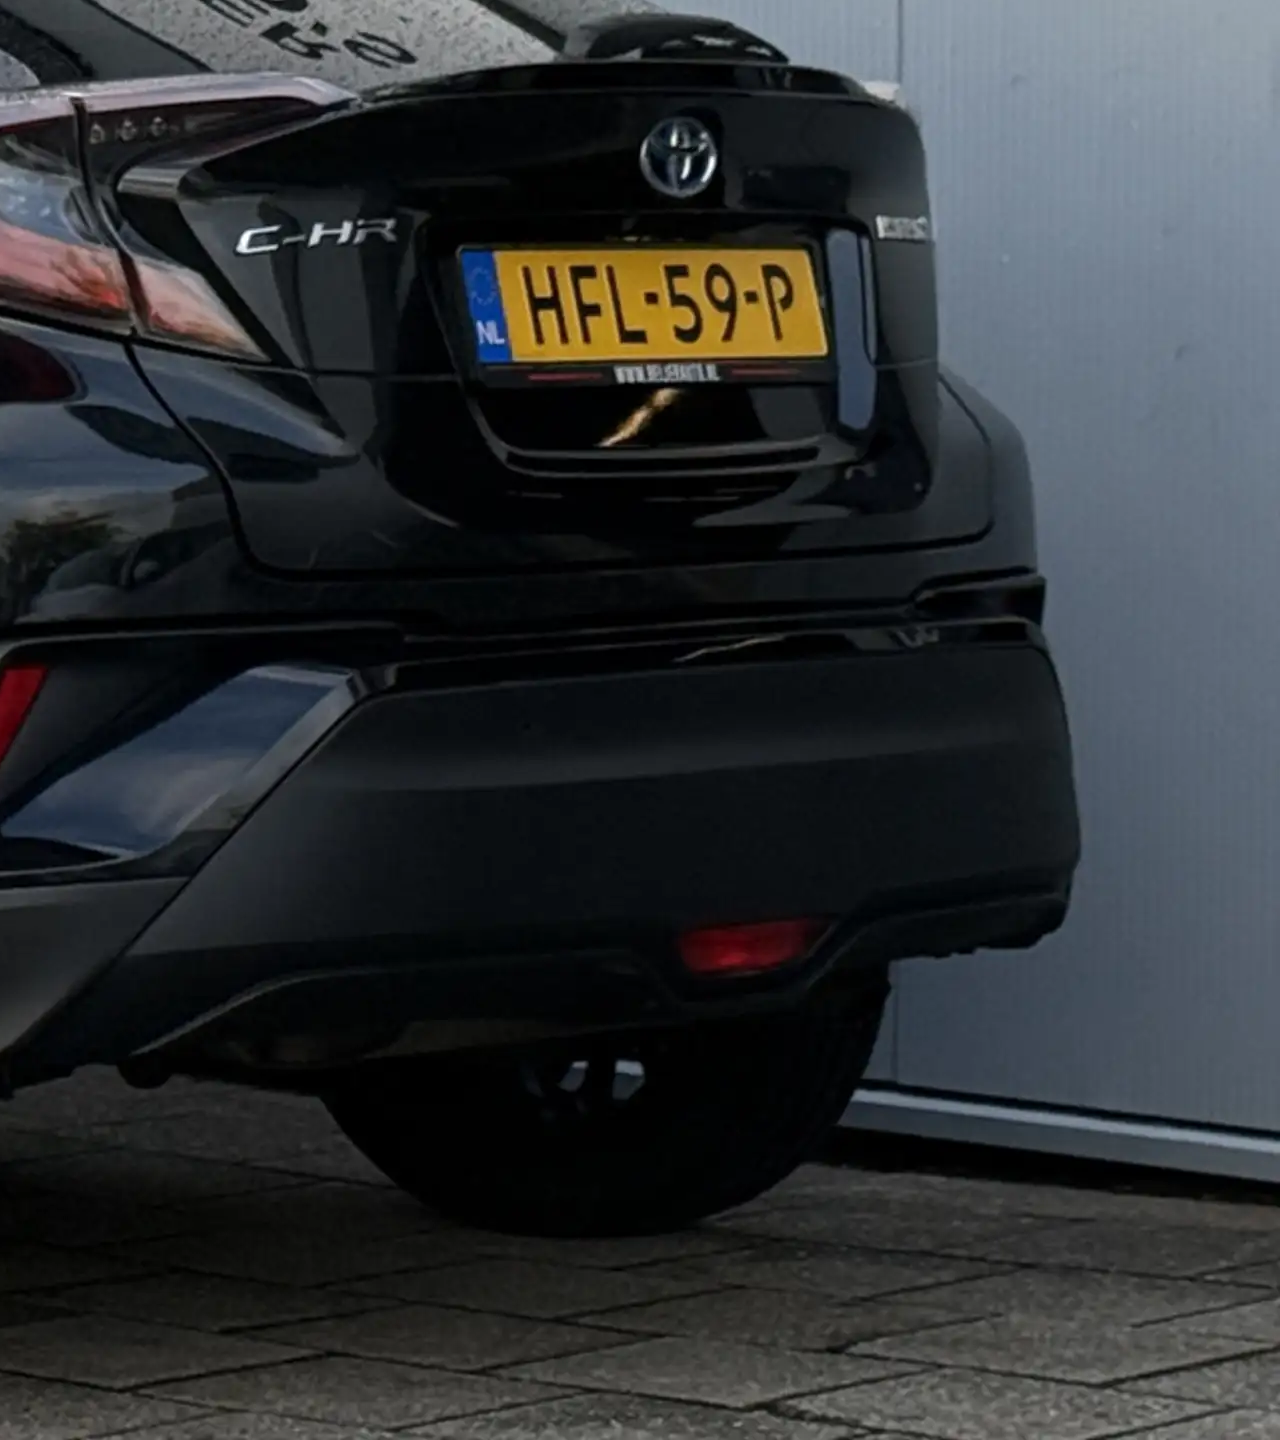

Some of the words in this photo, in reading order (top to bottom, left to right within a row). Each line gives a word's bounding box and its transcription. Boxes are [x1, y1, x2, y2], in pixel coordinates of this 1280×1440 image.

[235, 217, 397, 254] C-HR
[521, 262, 795, 346] HFL-59-P
[475, 320, 506, 345] NL
